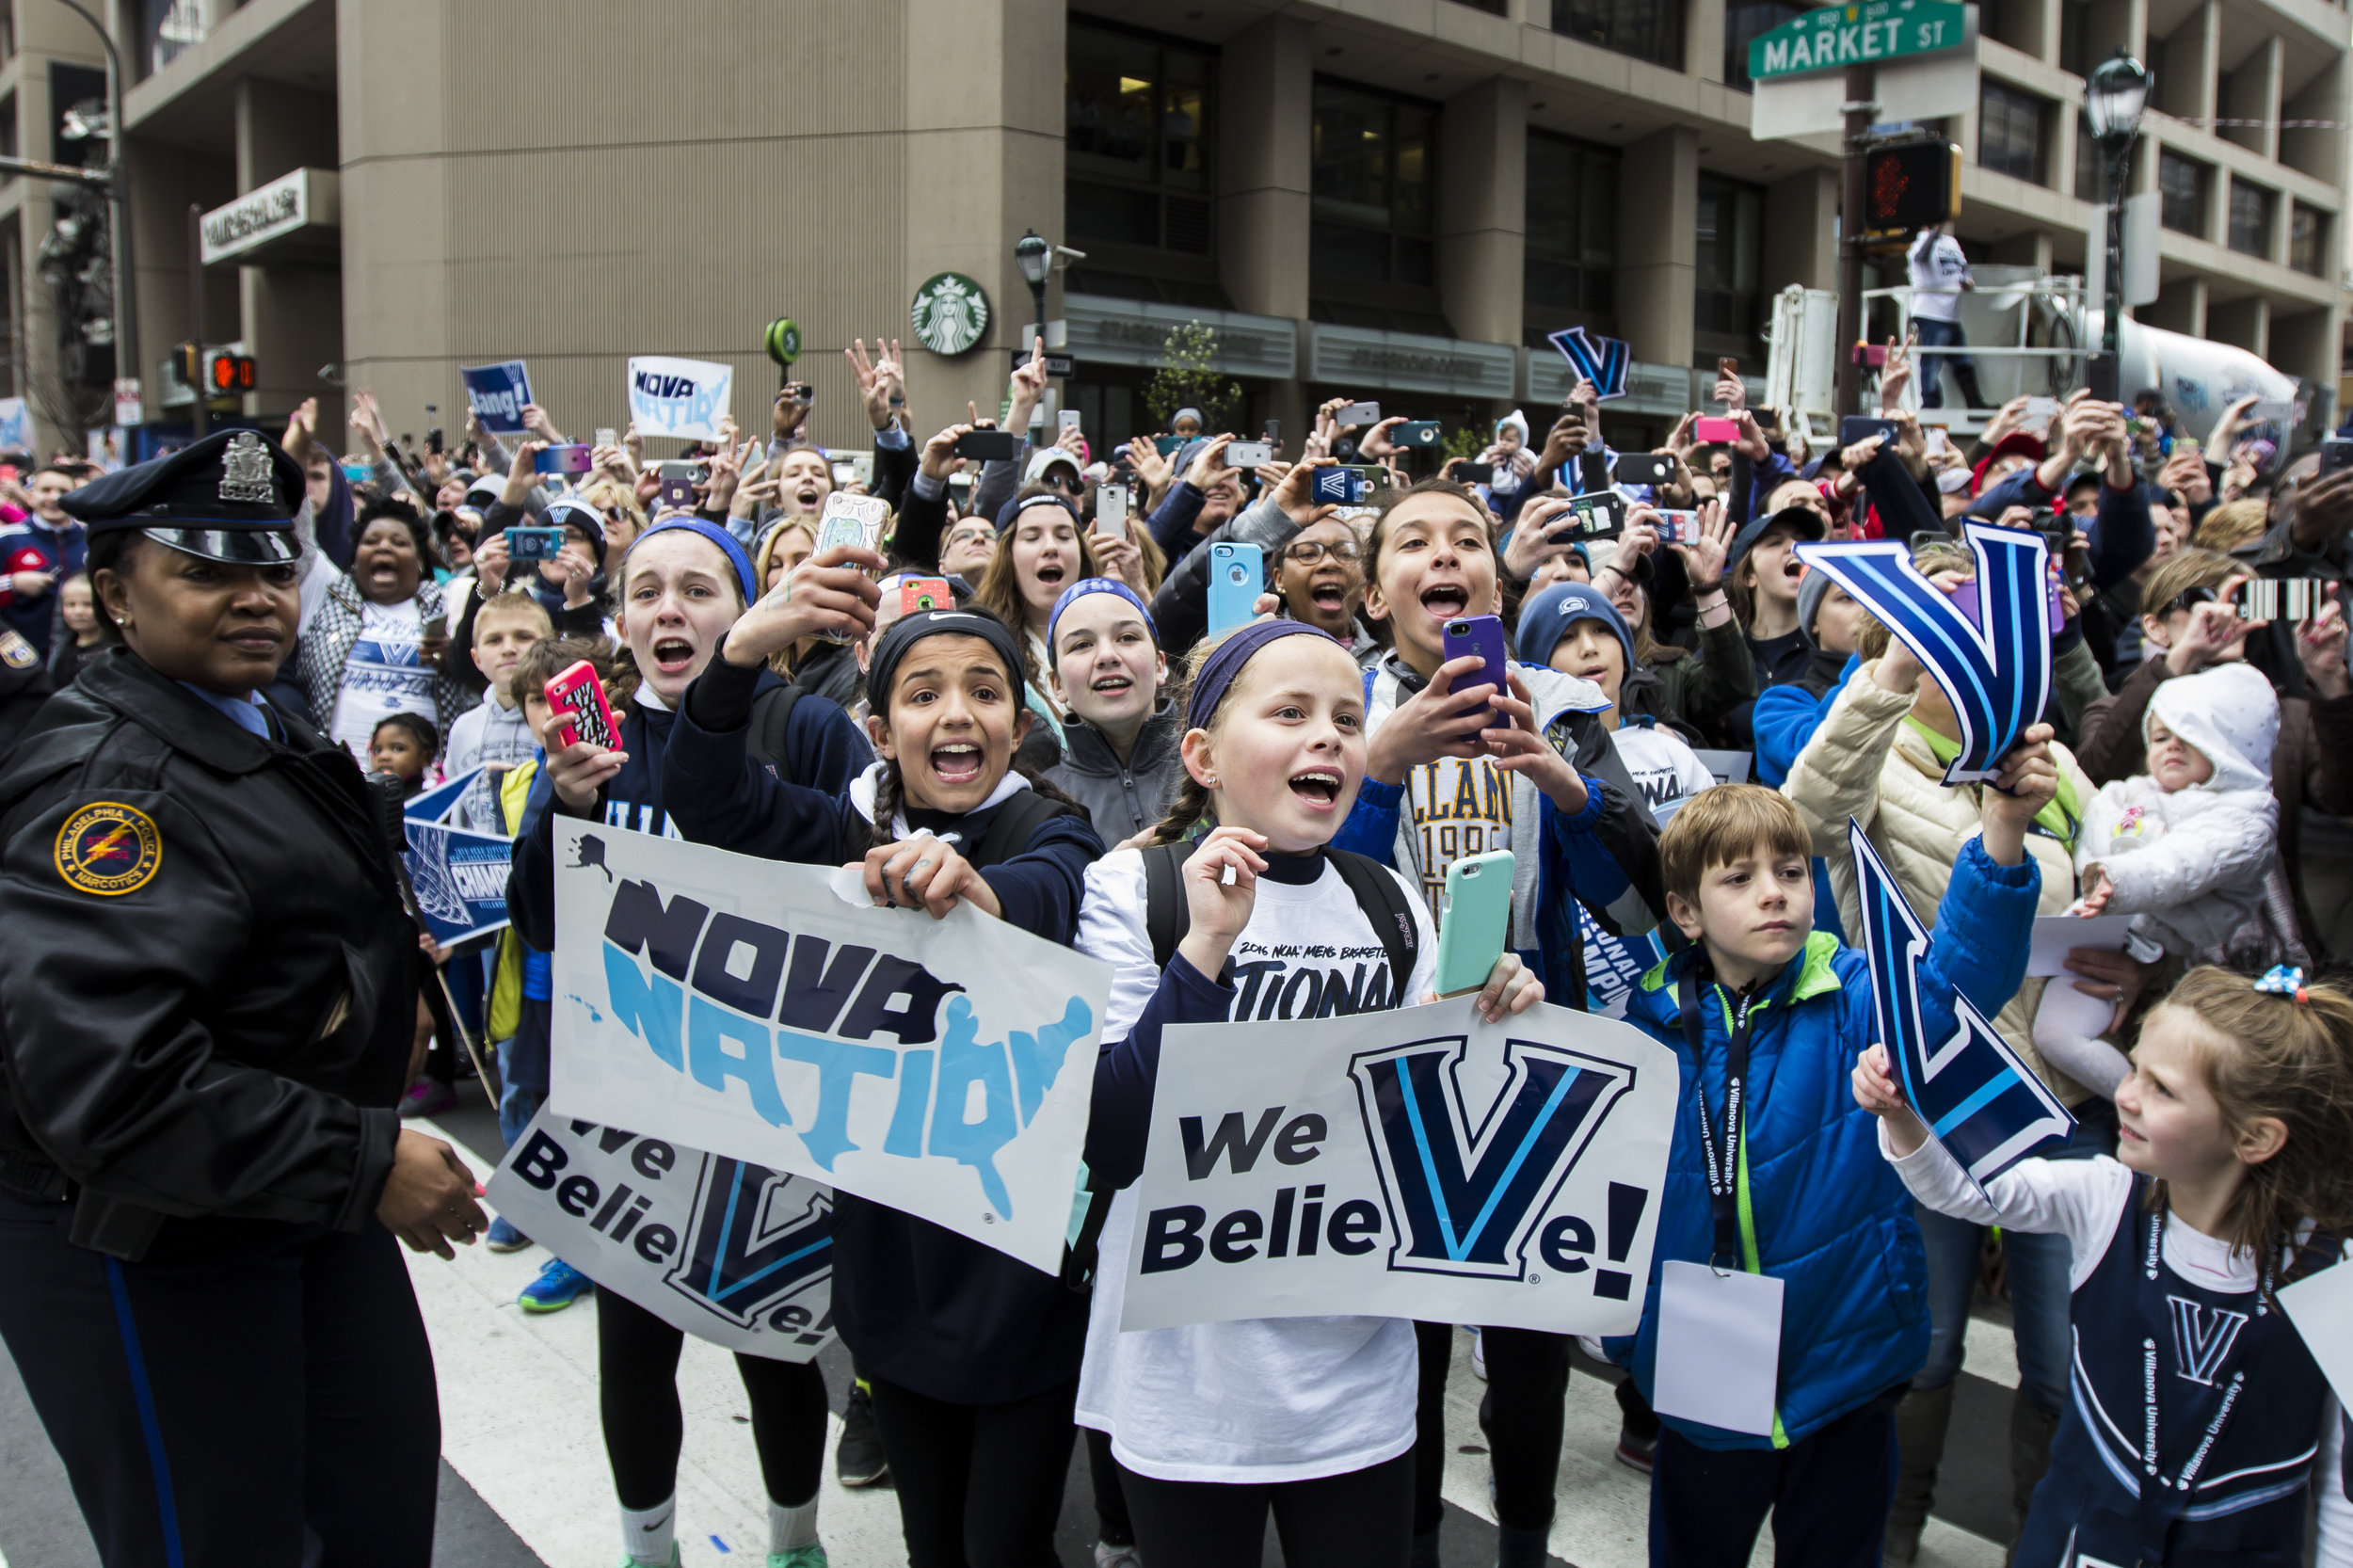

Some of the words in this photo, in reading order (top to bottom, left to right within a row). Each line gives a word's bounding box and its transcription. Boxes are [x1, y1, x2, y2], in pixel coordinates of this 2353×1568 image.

[1847, 4, 1860, 24] W
[1763, 17, 1904, 73] MARKET
[1917, 20, 1945, 49] ST
[635, 370, 698, 398] NOVA
[61, 808, 124, 861] PHILADELPHIA
[136, 820, 155, 857] POLICE
[75, 871, 144, 889] NARCOTICS
[451, 864, 511, 899] CHAMP
[603, 877, 966, 1045] NOVA
[1239, 941, 1268, 956] 2016
[1225, 954, 1397, 1023] TIONA
[1727, 1087, 1740, 1133] Villanova
[1178, 1105, 1328, 1182] We
[1723, 1135, 1737, 1184] University
[2143, 1350, 2157, 1404] Villanova
[2143, 1406, 2158, 1465] University
[2180, 1433, 2214, 1481] Villanova
[2207, 1384, 2243, 1434] University
